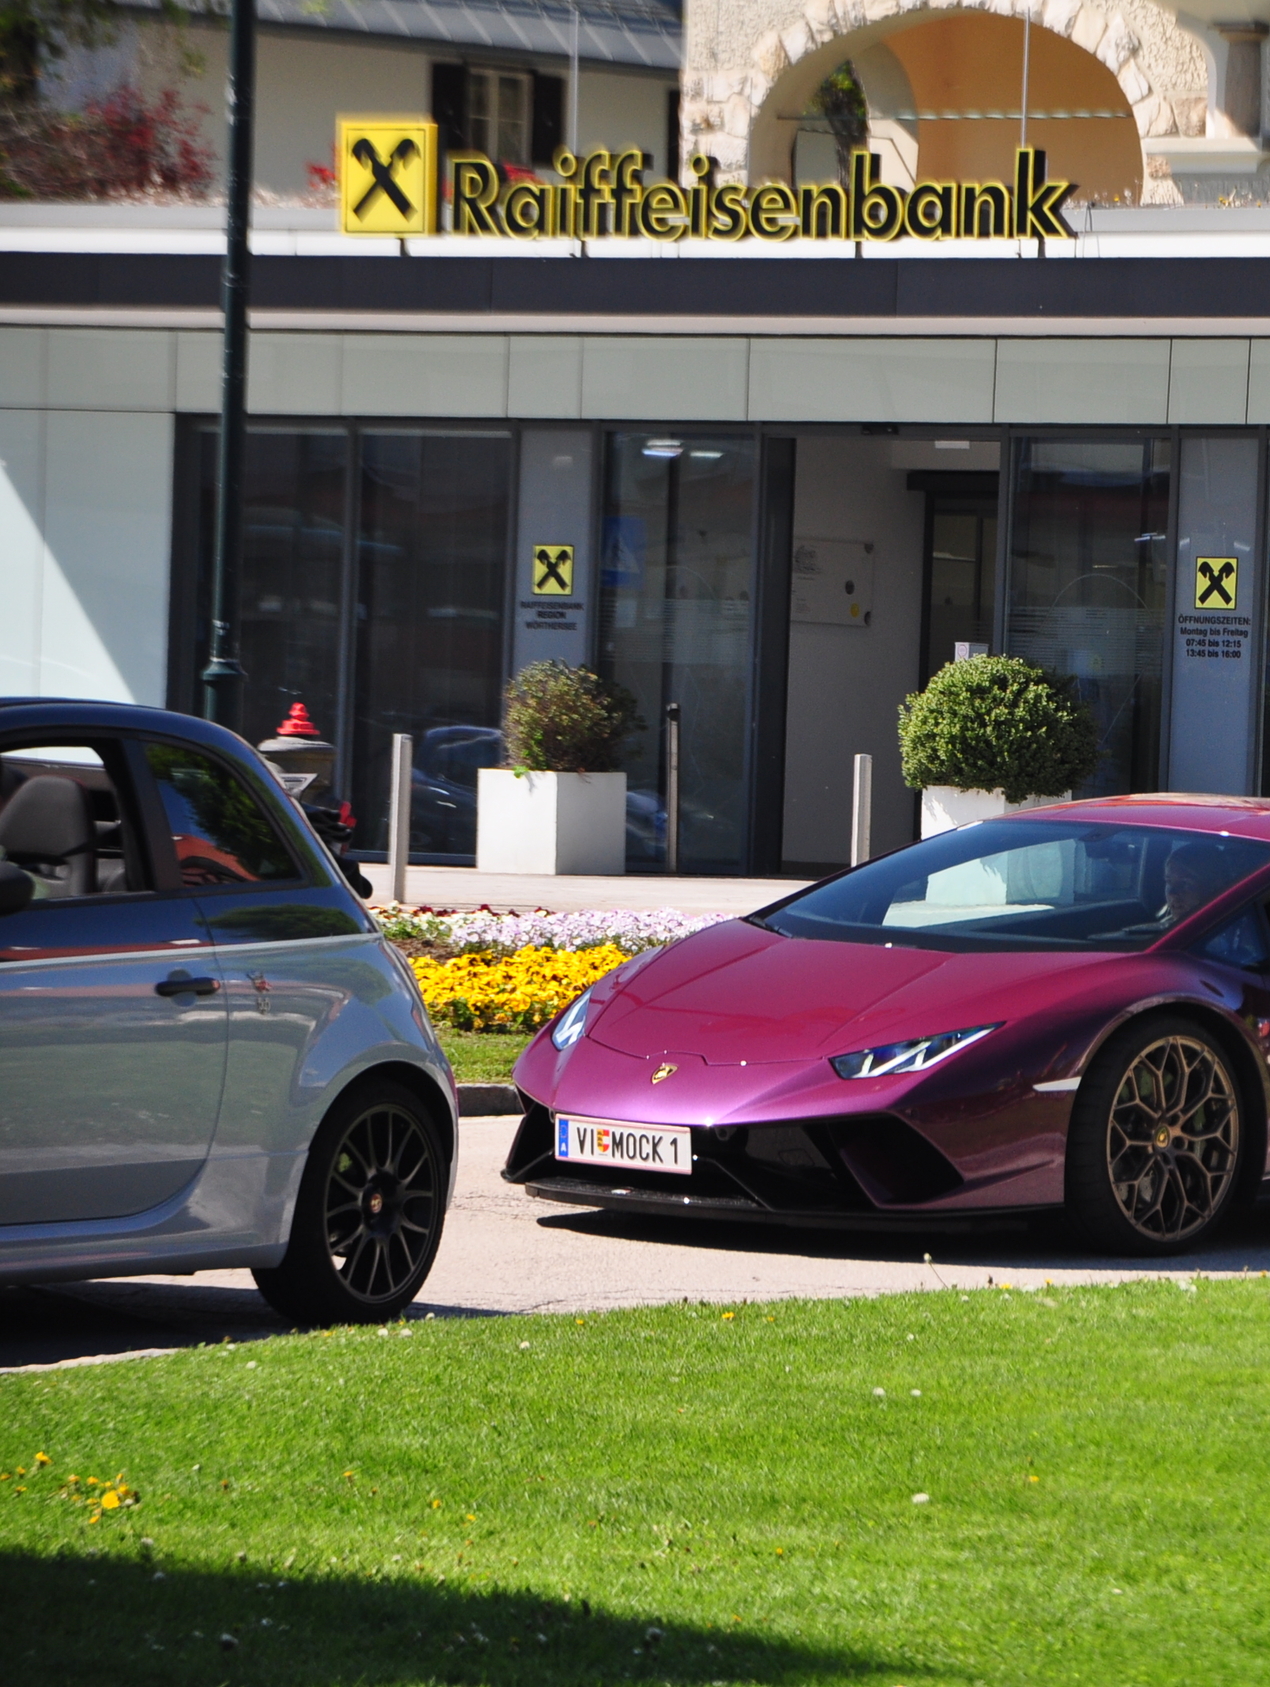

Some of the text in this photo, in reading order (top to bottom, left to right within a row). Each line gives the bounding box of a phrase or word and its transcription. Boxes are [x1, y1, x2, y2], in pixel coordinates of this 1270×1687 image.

[451, 147, 1070, 240] Raiffeisenbank
[537, 611, 566, 619] REGION
[1178, 614, 1251, 625] ÖFFNUNGSZEITEN:
[1180, 627, 1248, 638] Montag bis Freitag
[1186, 639, 1241, 648] 07:45 bis 12:15
[1186, 649, 1241, 658] 13:45 bis 16:00
[560, 1143, 567, 1152] A
[577, 1127, 678, 1165] VI MOCK 1
